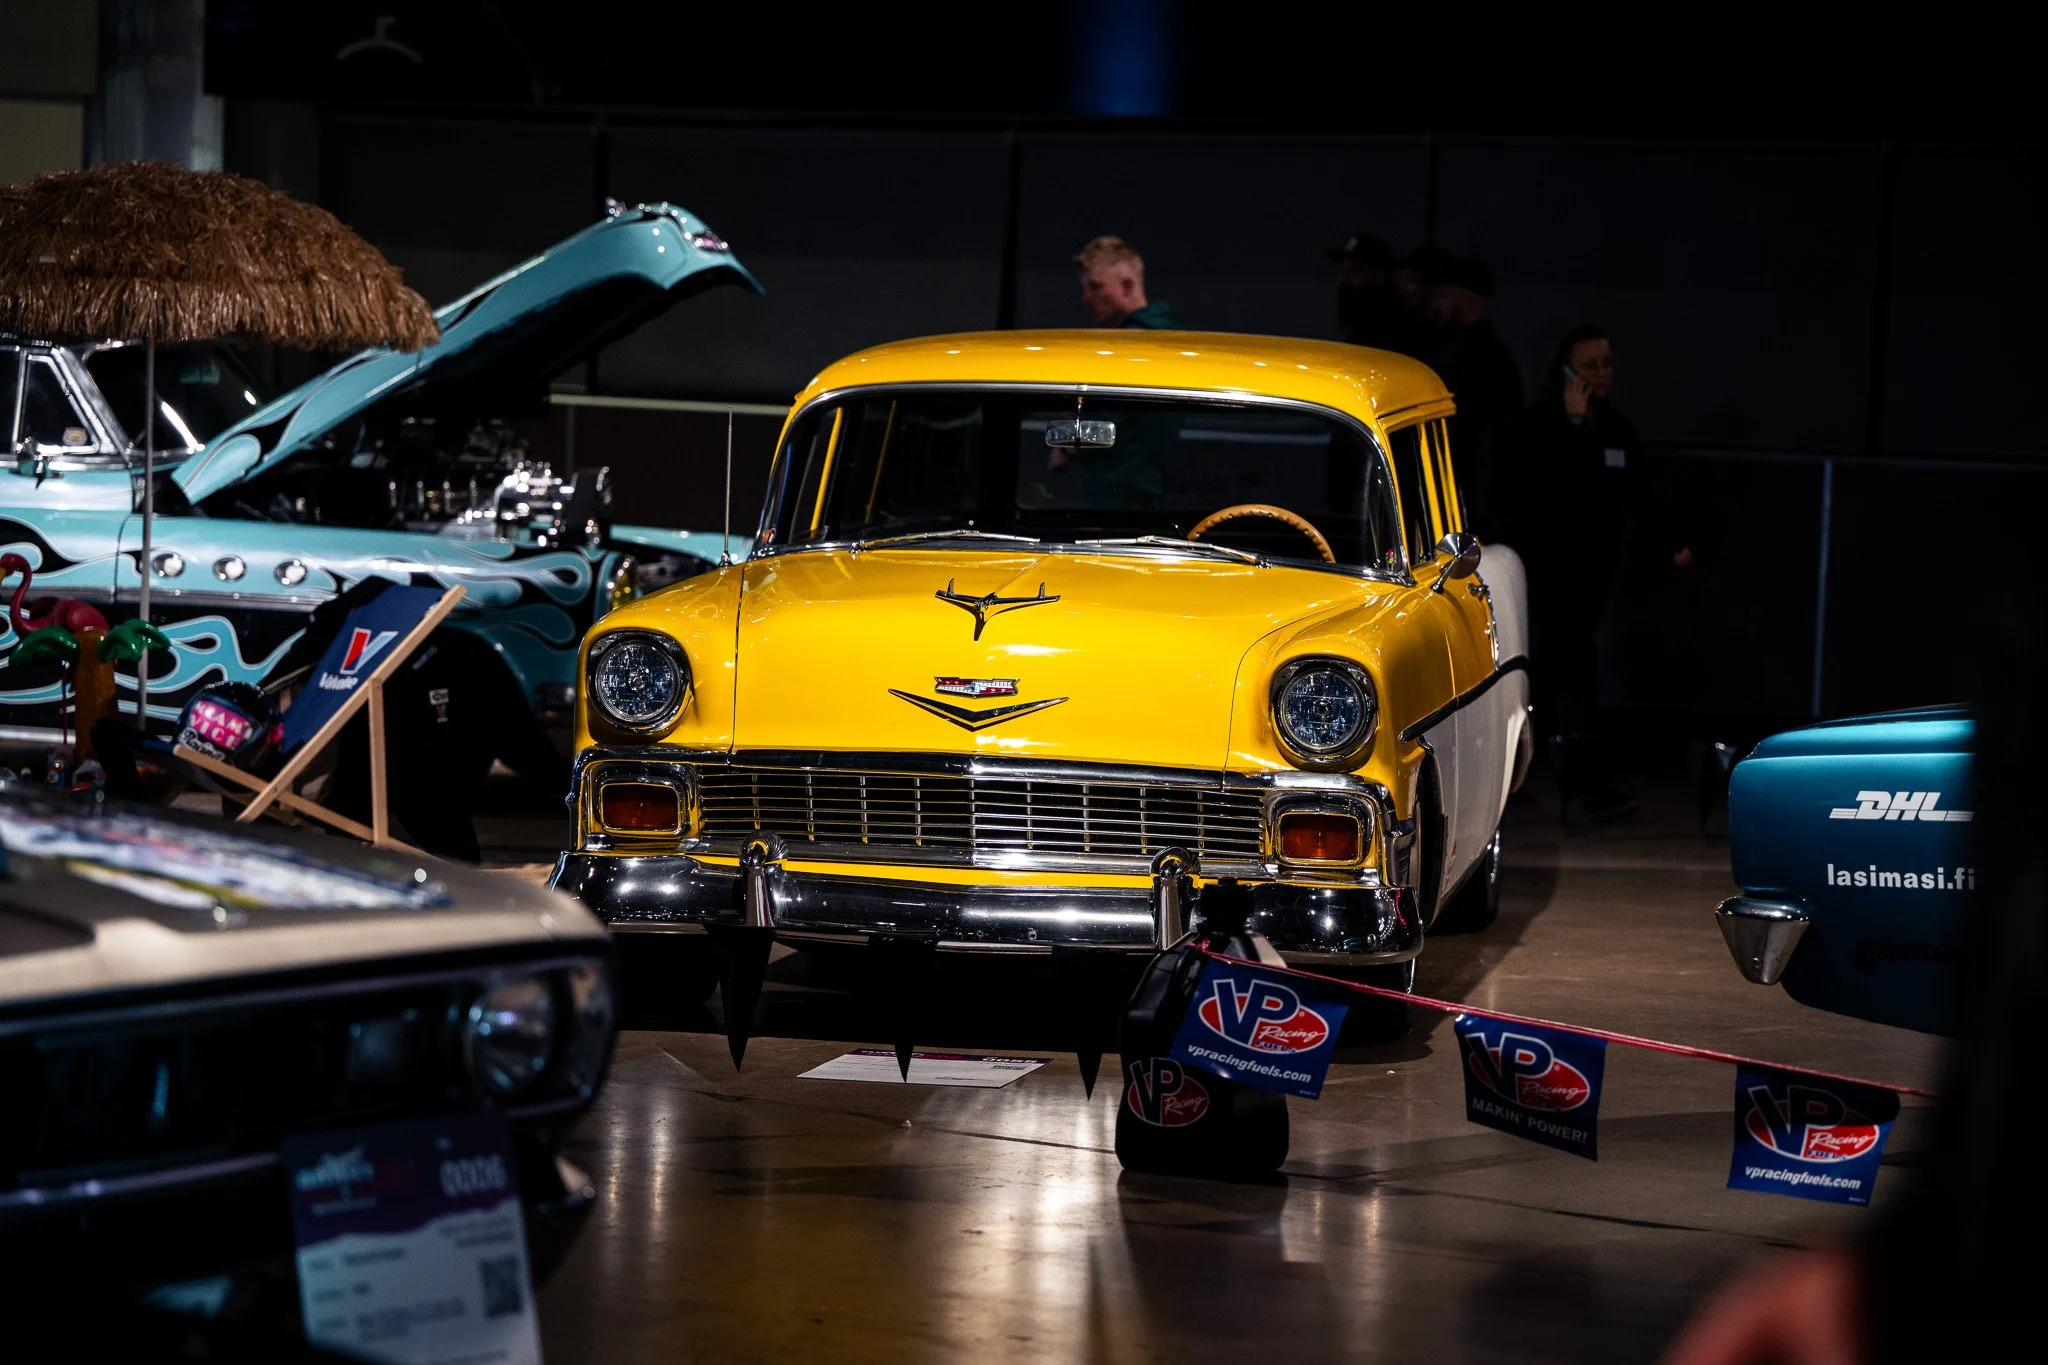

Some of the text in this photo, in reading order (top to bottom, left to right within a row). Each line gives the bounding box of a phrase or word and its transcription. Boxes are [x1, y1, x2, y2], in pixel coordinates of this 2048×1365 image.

[1853, 790, 1948, 822] DHL
[1827, 863, 1975, 890] lasimasi.fi
[1211, 978, 1301, 1050] VP
[1258, 1025, 1325, 1043] Racing
[1187, 1042, 1312, 1084] vpracingfuels.com
[1464, 1031, 1555, 1103] VP
[1128, 1056, 1185, 1124] VP
[1163, 1096, 1207, 1116] Racing
[1520, 1081, 1587, 1101] Racing
[1472, 1096, 1523, 1124] MAKIN'
[1527, 1116, 1589, 1144] POWER!
[1747, 1083, 1848, 1157] VP
[1809, 1131, 1876, 1151] Racing
[1744, 1164, 1862, 1189] vpracingfuels.com
